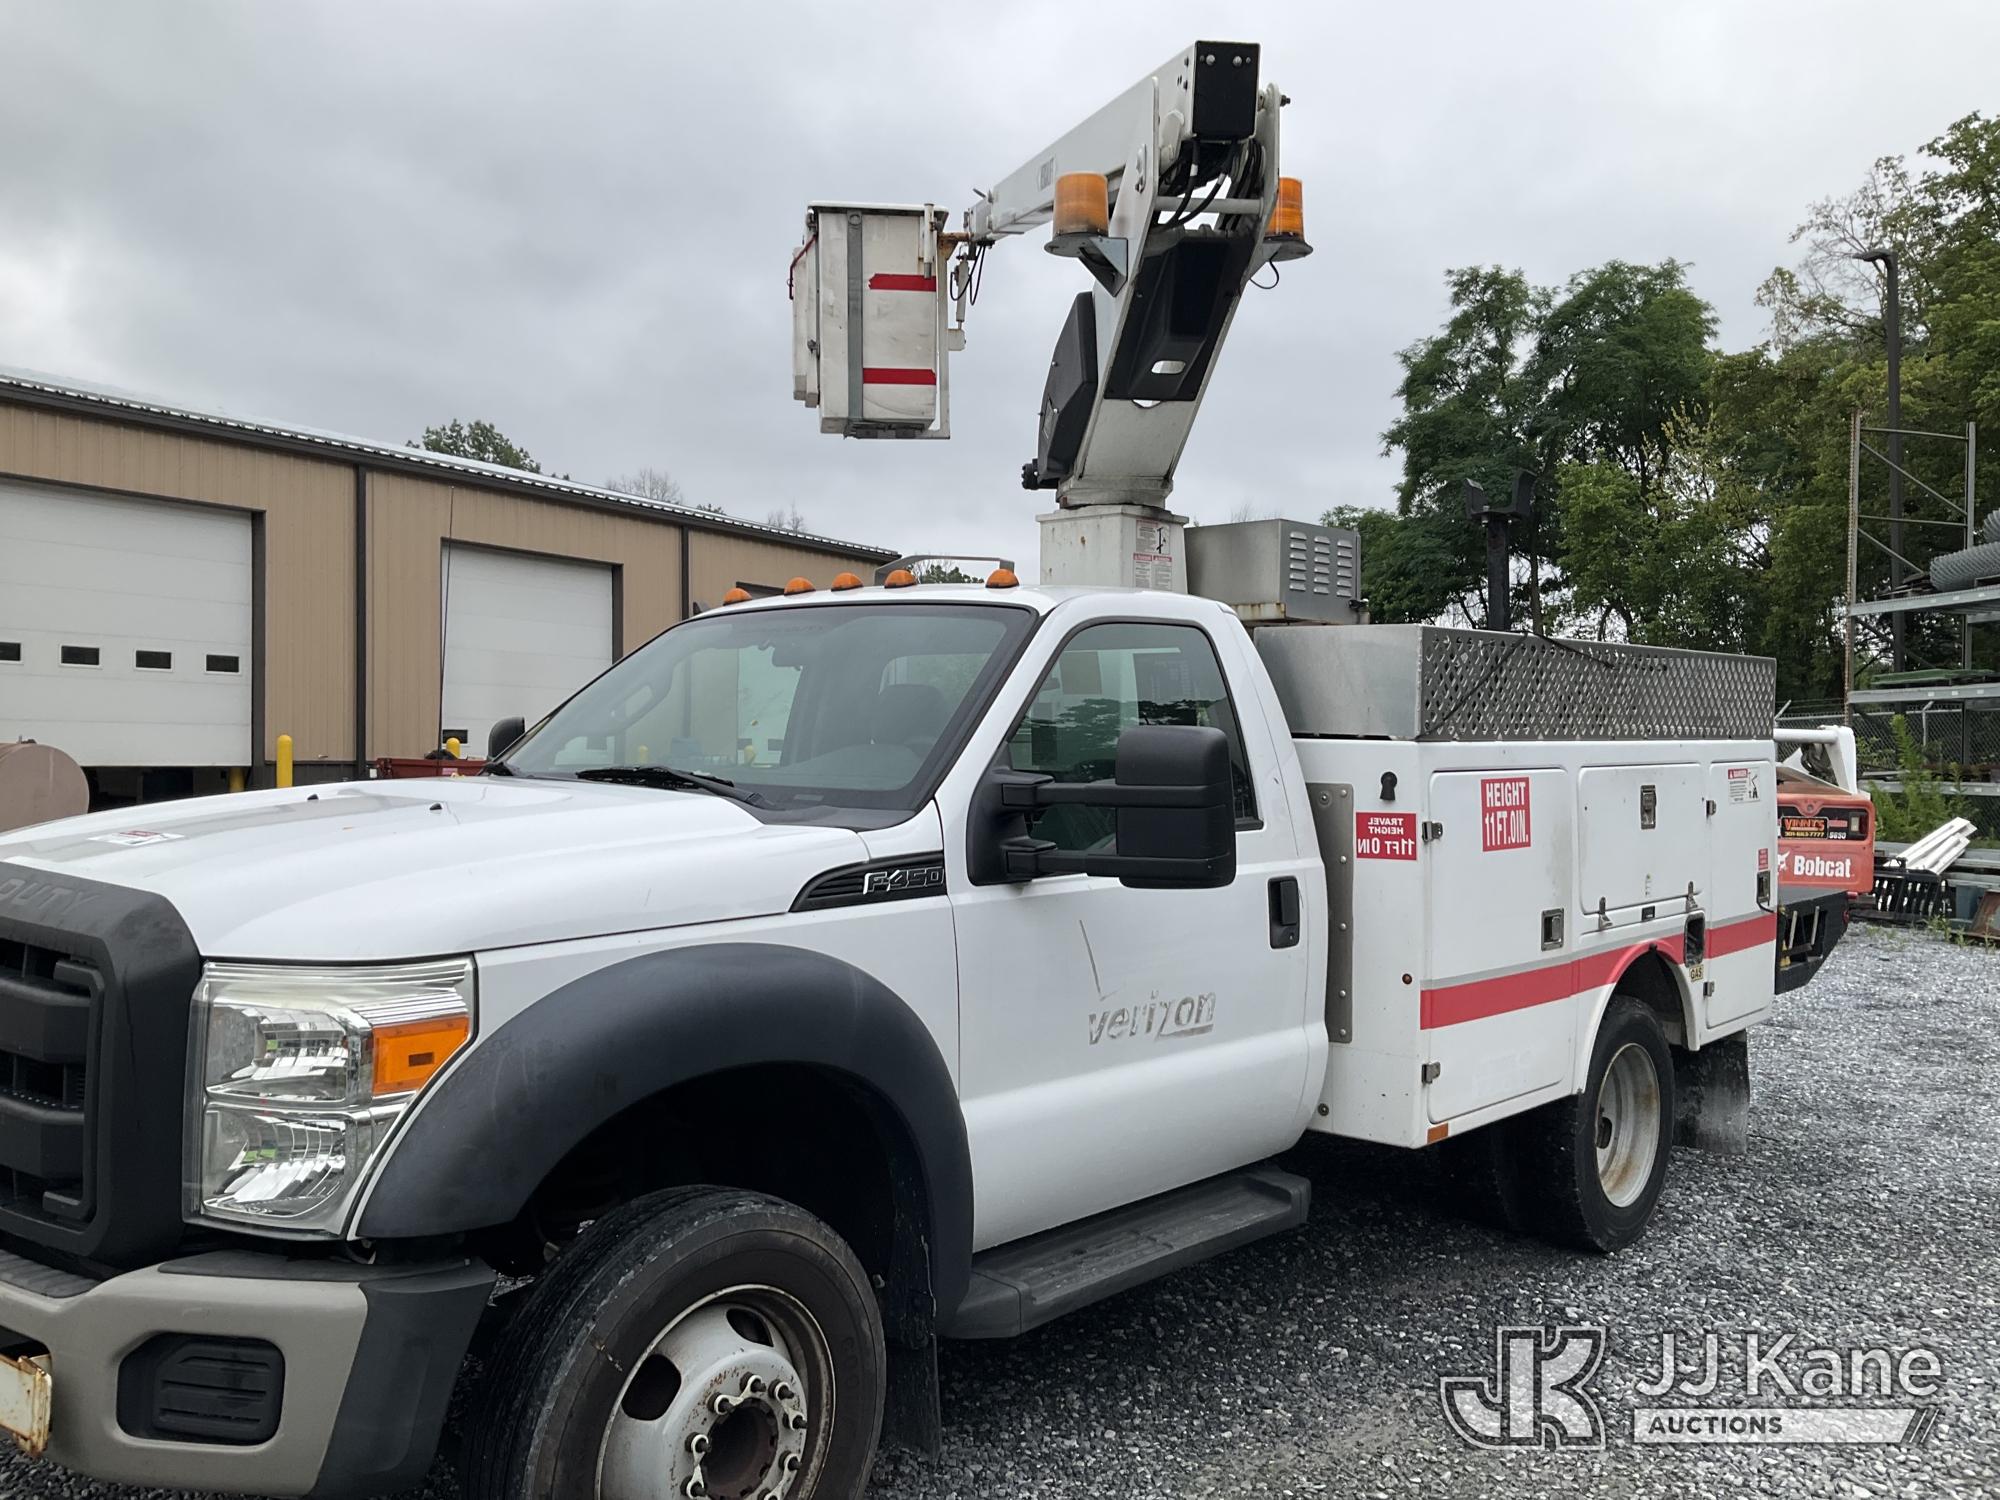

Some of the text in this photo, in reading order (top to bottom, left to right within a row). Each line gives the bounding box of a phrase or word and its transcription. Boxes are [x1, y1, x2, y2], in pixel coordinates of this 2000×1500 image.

[1486, 782, 1526, 807] HEIGHT
[1793, 855, 1852, 878] Bobcat
[0, 878, 101, 916] DUTY
[1690, 966, 1703, 980] GAS
[1088, 991, 1217, 1046] verizon
